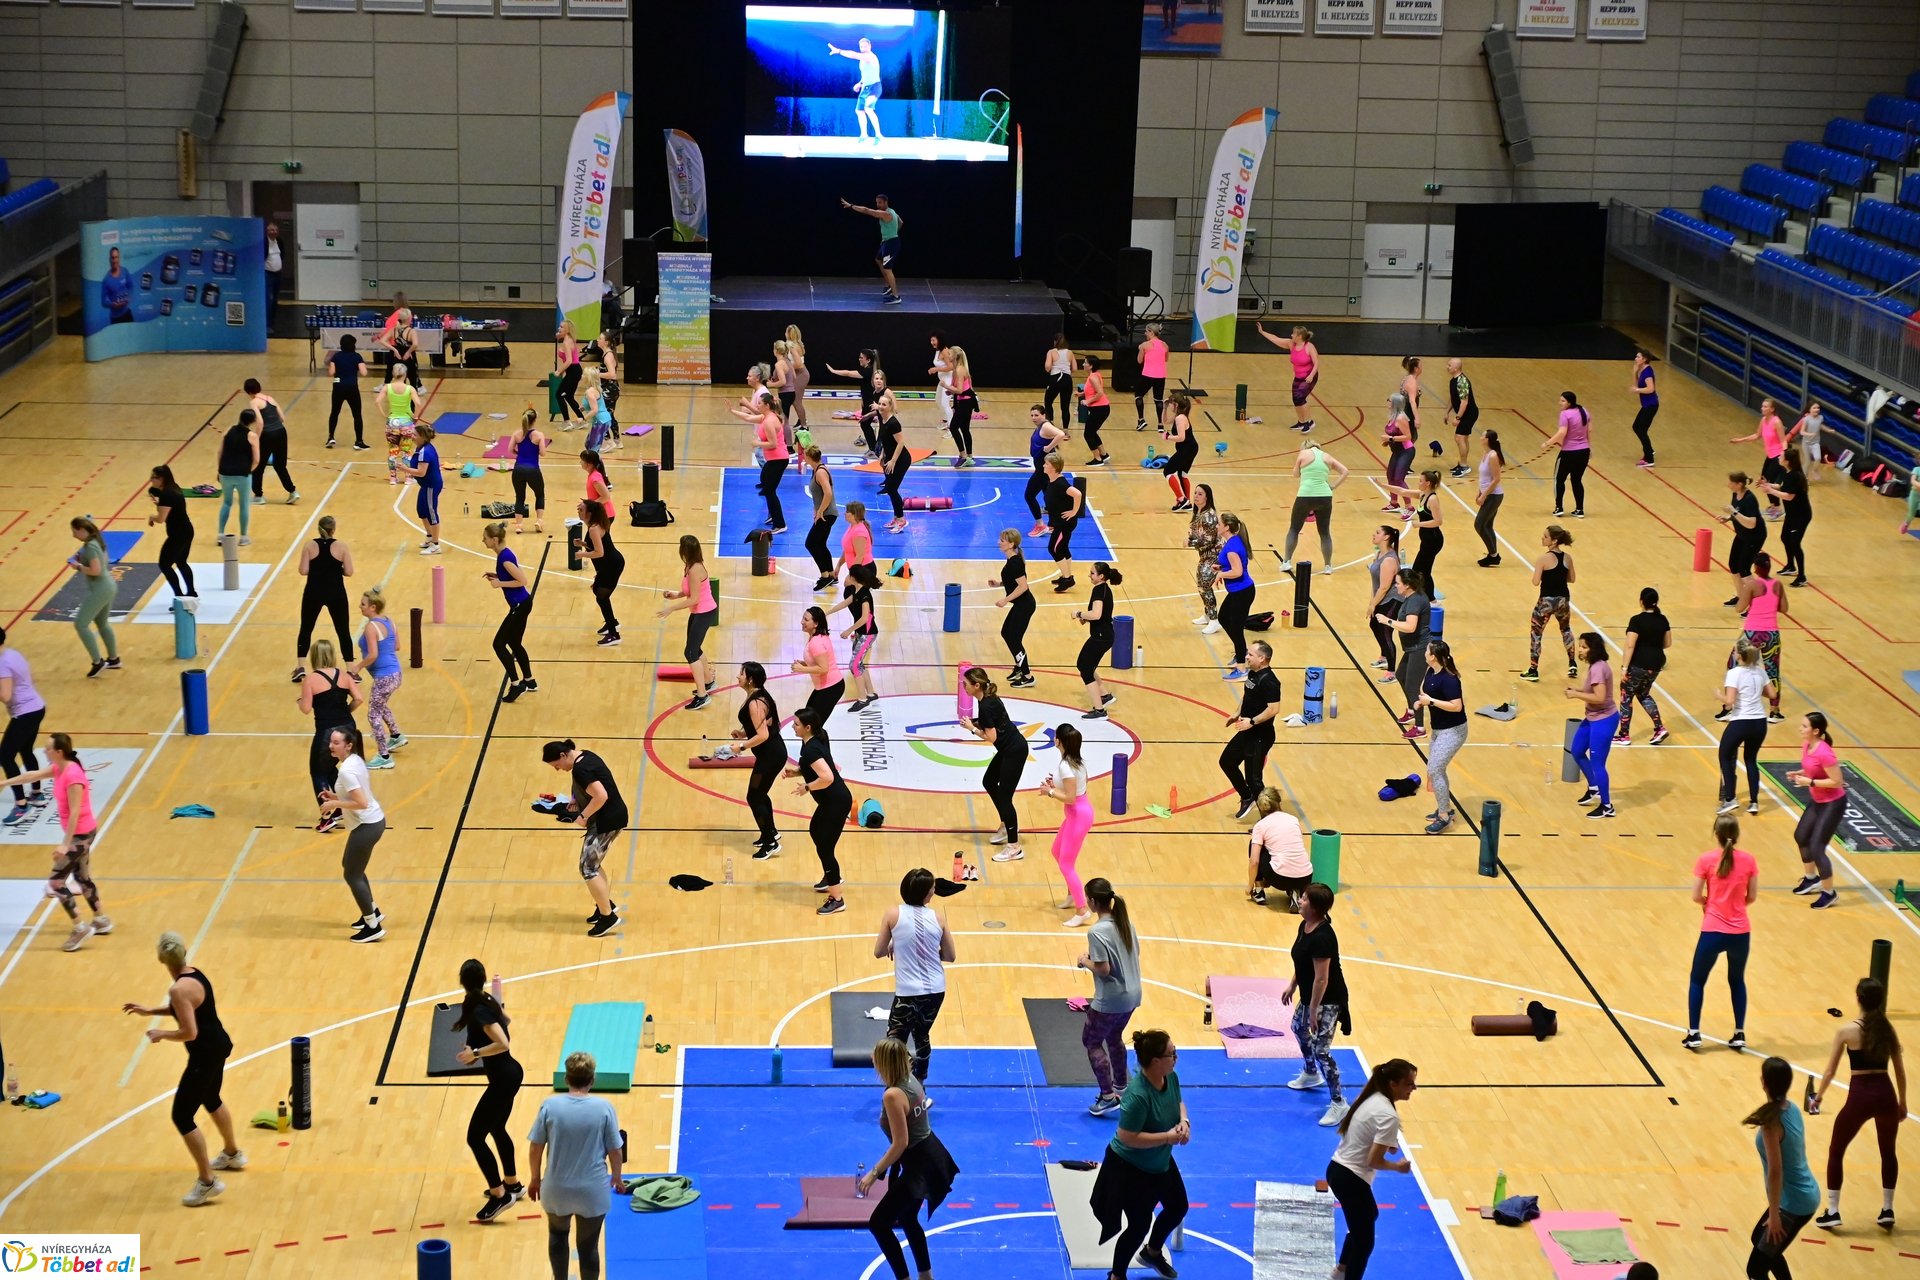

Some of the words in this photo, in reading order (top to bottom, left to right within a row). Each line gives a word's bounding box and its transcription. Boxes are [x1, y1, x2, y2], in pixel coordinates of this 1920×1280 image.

[1261, 8, 1300, 19] HELYEZÉS
[1331, 10, 1370, 21] HELYEZÉS
[1399, 11, 1438, 22] HELYEZÉS
[593, 133, 611, 168] ad!
[569, 159, 587, 238] NYÍREGYHÁZA
[583, 171, 606, 238] Többet
[1211, 172, 1231, 250] NYÍREGYHÁZA
[1223, 184, 1247, 251] Többet
[1238, 147, 1255, 182] ad!
[859, 710, 893, 771] NYÍREGYHÁZA
